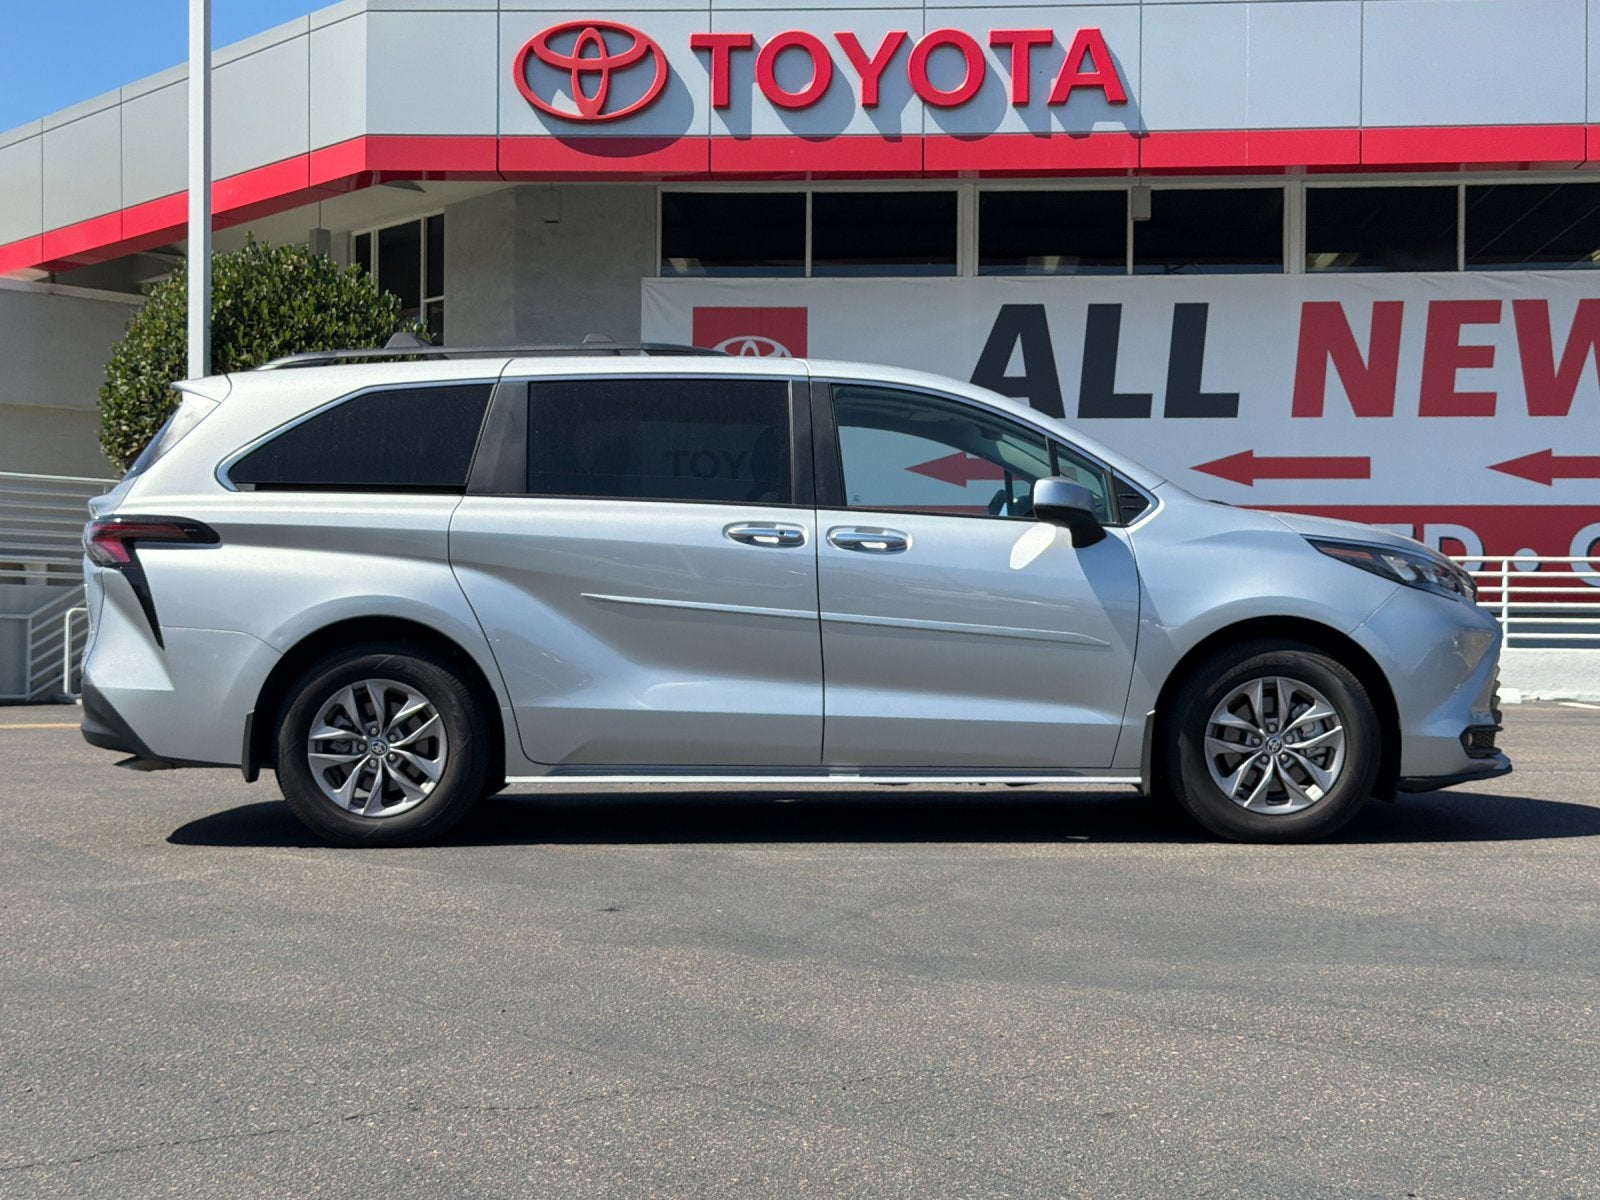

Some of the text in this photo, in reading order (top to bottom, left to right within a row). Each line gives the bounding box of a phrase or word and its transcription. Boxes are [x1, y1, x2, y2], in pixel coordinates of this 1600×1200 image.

[690, 28, 1128, 109] TOYOTA
[968, 298, 1600, 418] ALL NEW
